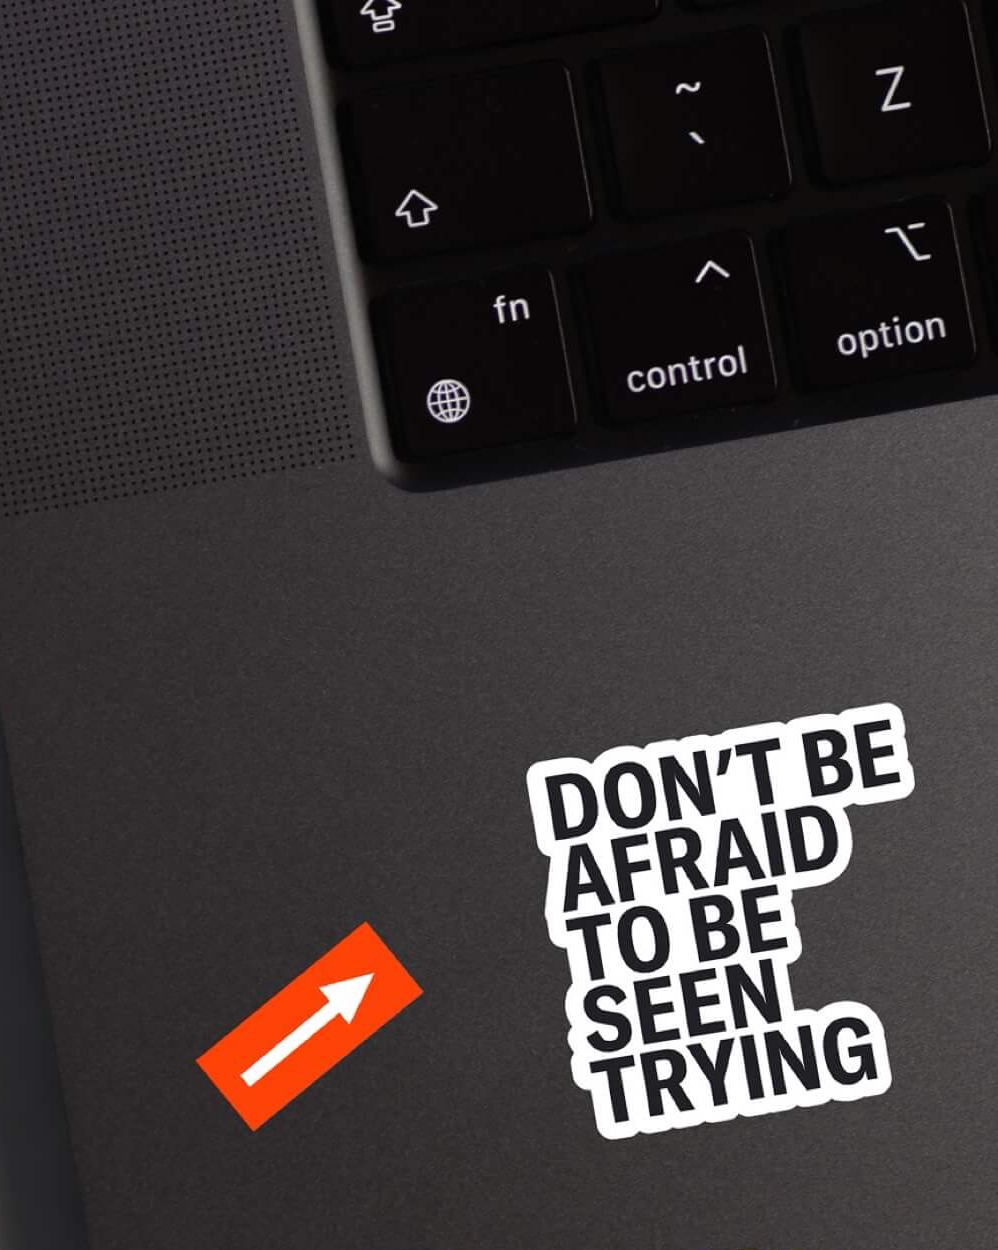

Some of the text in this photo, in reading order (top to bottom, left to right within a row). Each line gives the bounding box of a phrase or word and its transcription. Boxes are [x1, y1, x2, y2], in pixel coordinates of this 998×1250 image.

[875, 66, 912, 112] Z
[493, 295, 530, 323] fn
[837, 314, 946, 359] option
[626, 346, 747, 393] control
[802, 719, 901, 797] BE
[562, 805, 839, 913] AFRAID
[565, 884, 788, 982] TO BE
[583, 958, 783, 1053] SEEN
[590, 1016, 878, 1124] TRYING
